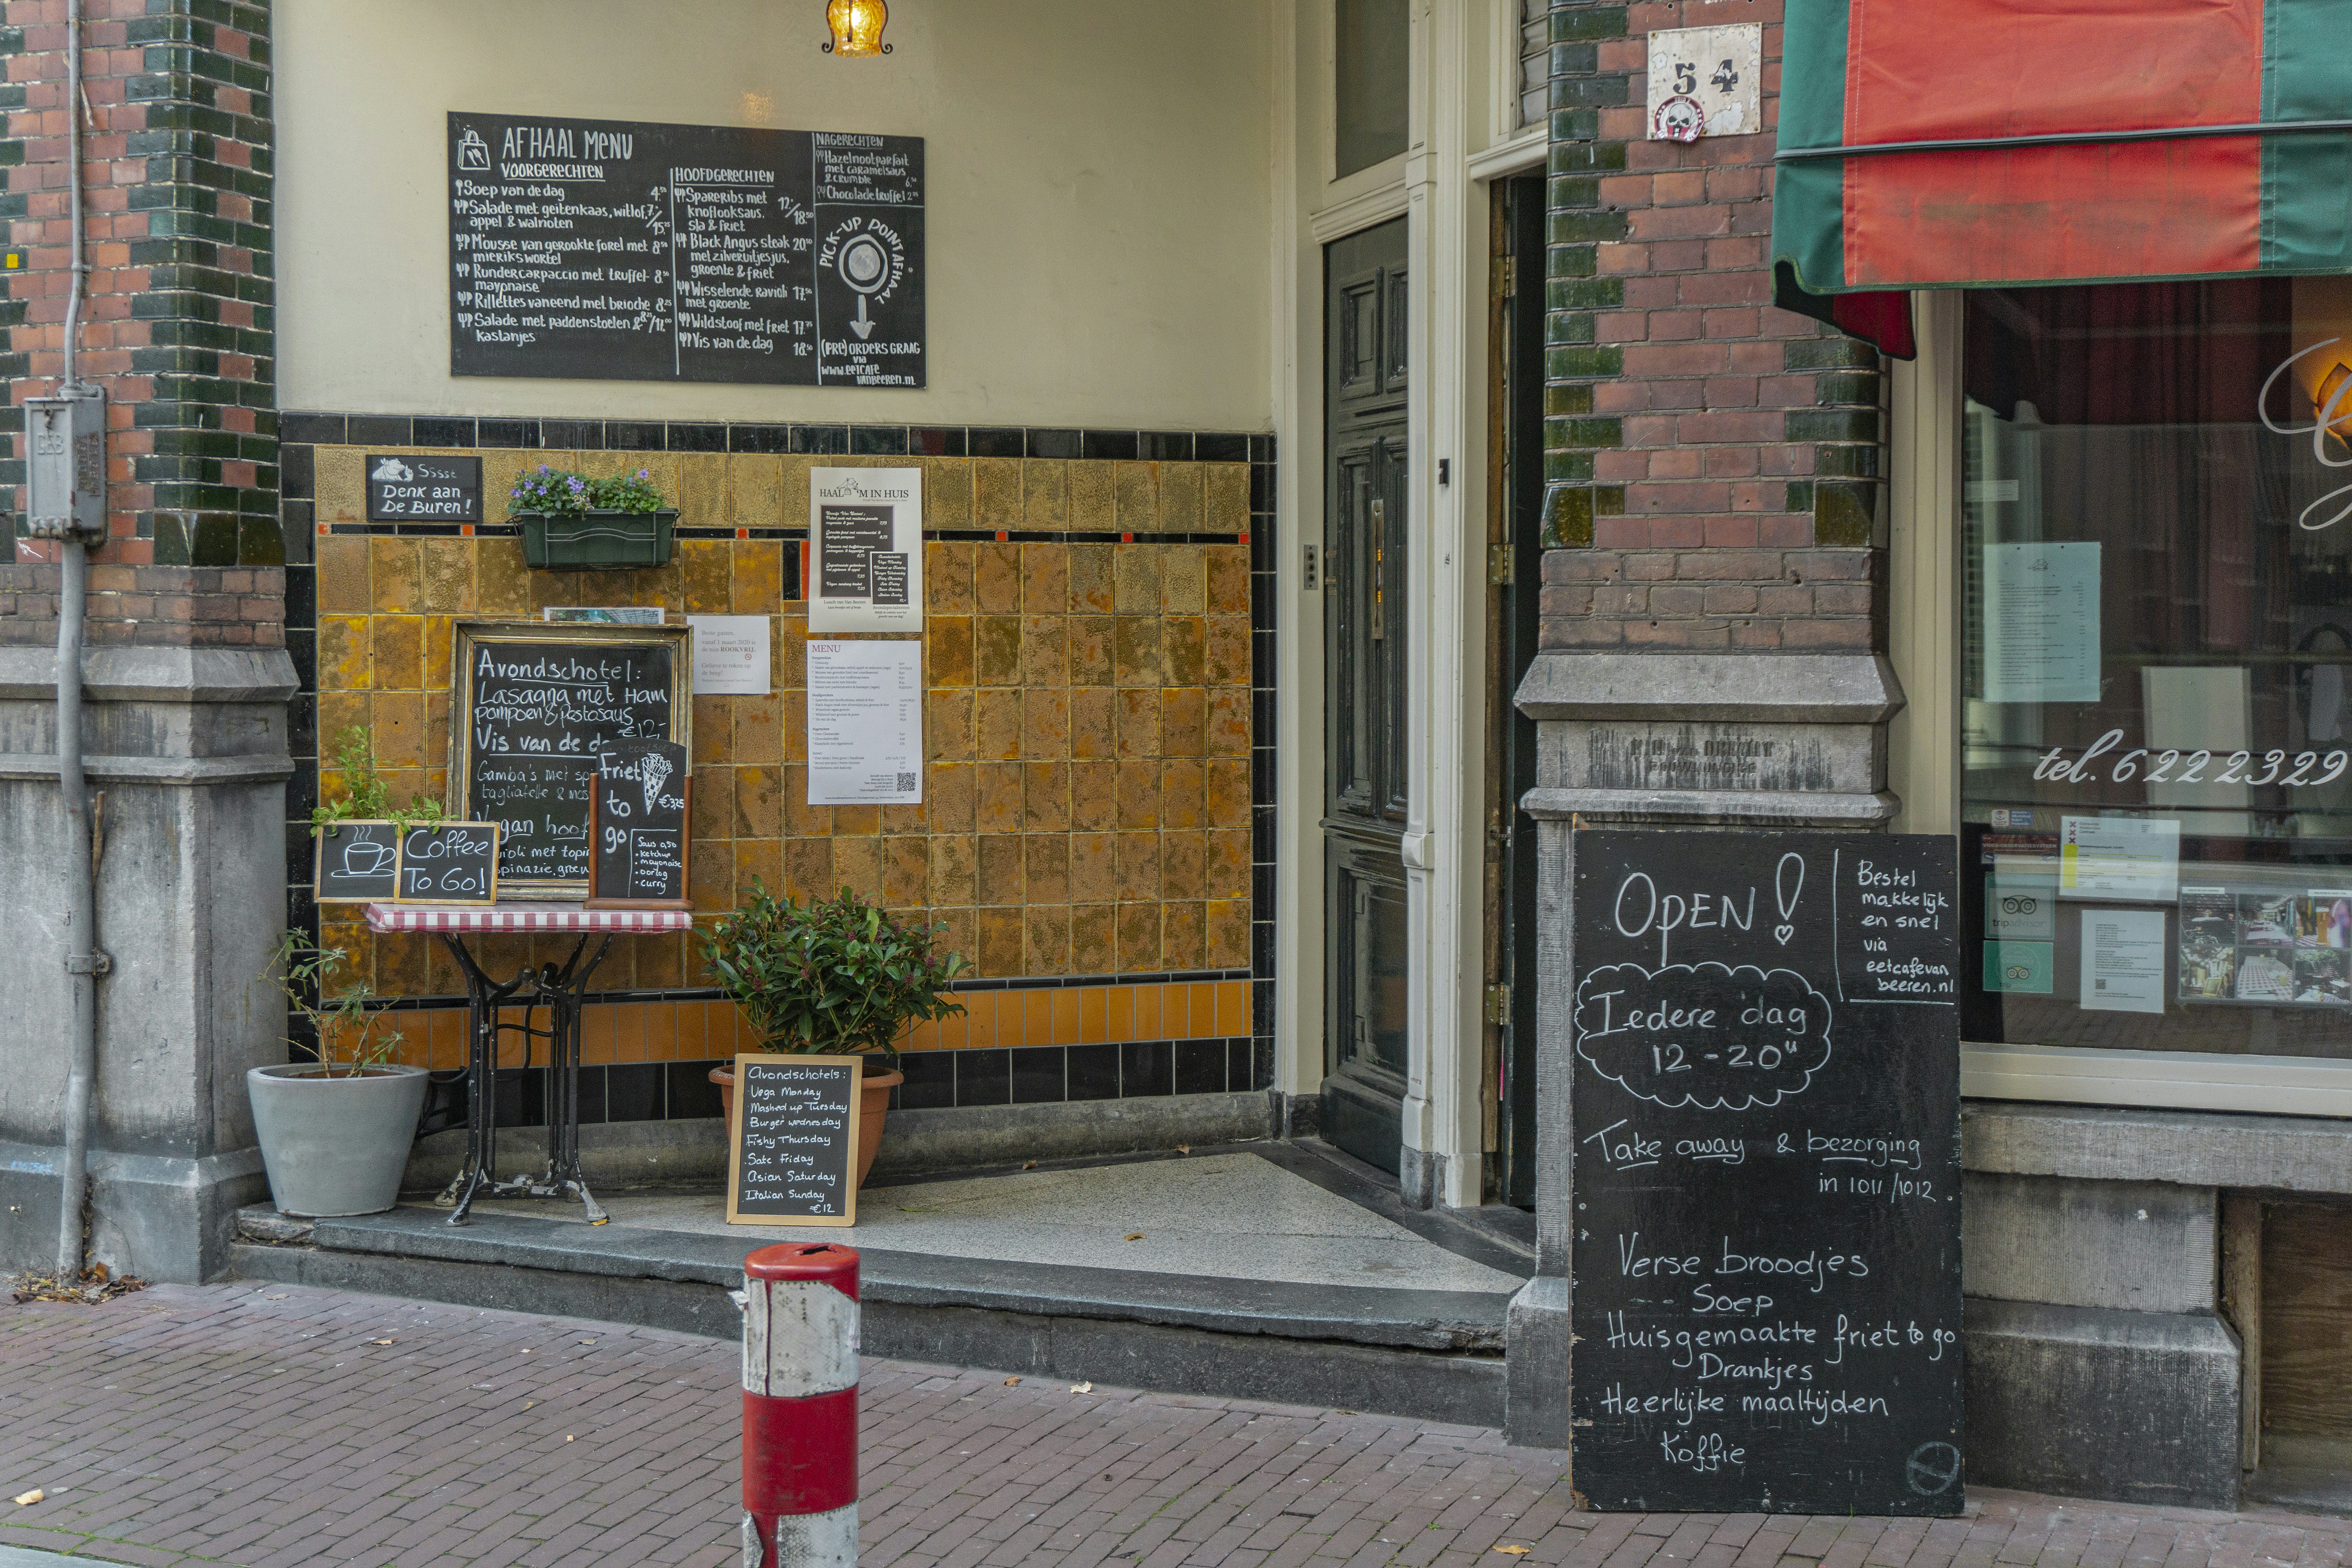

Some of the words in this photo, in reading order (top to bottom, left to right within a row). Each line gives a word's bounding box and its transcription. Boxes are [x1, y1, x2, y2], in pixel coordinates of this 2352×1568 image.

[503, 127, 576, 159] AFHAAL
[464, 180, 498, 198] Soep
[501, 186, 524, 196] van
[527, 185, 541, 196] de
[543, 184, 564, 201] dag
[746, 191, 767, 204] met
[469, 200, 512, 214] Salade
[515, 203, 539, 214] met
[470, 215, 502, 230] appel
[508, 216, 515, 227] &
[518, 217, 573, 228] walnoten
[690, 233, 721, 249] Black
[724, 235, 758, 251] Angus
[760, 234, 789, 248] steak
[867, 218, 903, 251] POINT
[693, 332, 710, 348] Vis
[713, 338, 734, 348] van
[737, 336, 751, 348] de
[752, 335, 773, 354] dag
[890, 342, 920, 354] GRAAG
[383, 485, 426, 498] Denk
[432, 487, 460, 498] aan
[820, 489, 844, 497] HAAL
[381, 500, 405, 512] De
[577, 686, 615, 706] met
[625, 688, 667, 703] Ham
[477, 724, 509, 751] Vis
[520, 731, 551, 751] van
[559, 732, 580, 751] de
[2033, 728, 2125, 783] tel.
[546, 767, 568, 781] met
[600, 753, 642, 781] Friet
[606, 790, 631, 817] to
[406, 830, 488, 858] Coffee
[606, 827, 626, 853] go
[404, 868, 432, 893] To
[1858, 860, 1915, 886] Bestel
[641, 880, 666, 894] curry
[1862, 915, 1887, 927] en
[1895, 915, 1938, 930] snel
[1864, 937, 1887, 951] via
[1584, 990, 1715, 1040] Iedere
[1741, 994, 1806, 1034] dag
[751, 1085, 775, 1100] Vega
[782, 1087, 821, 1100] Monday
[751, 1103, 787, 1113] Mashed
[790, 1105, 802, 1113] up
[804, 1102, 847, 1113] Tuesday
[750, 1116, 784, 1130] Burger
[747, 1134, 775, 1149] Fishy
[778, 1135, 830, 1146] Thursday
[1583, 1119, 1661, 1162] Take
[1676, 1138, 1744, 1164] away
[1777, 1133, 1795, 1153] &
[1808, 1129, 1921, 1170] bezorging
[780, 1153, 813, 1165] Friday
[787, 1170, 835, 1186] Saturday
[1820, 1173, 1837, 1192] in
[745, 1190, 783, 1200] Italian
[789, 1189, 824, 1202] Sunday
[1619, 1232, 1700, 1277] Verse
[1715, 1236, 1868, 1292] broodjes
[1692, 1283, 1773, 1316] Soep
[1607, 1308, 1816, 1369] Huisgemaakte
[1825, 1314, 1899, 1364] friet
[1907, 1321, 1924, 1344] to
[1929, 1328, 1955, 1361] go
[1698, 1353, 1812, 1390] Drankjes
[1601, 1382, 1724, 1425] Heerlijke
[1743, 1389, 1888, 1425] maaltijden
[1661, 1431, 1745, 1472] Koffie
